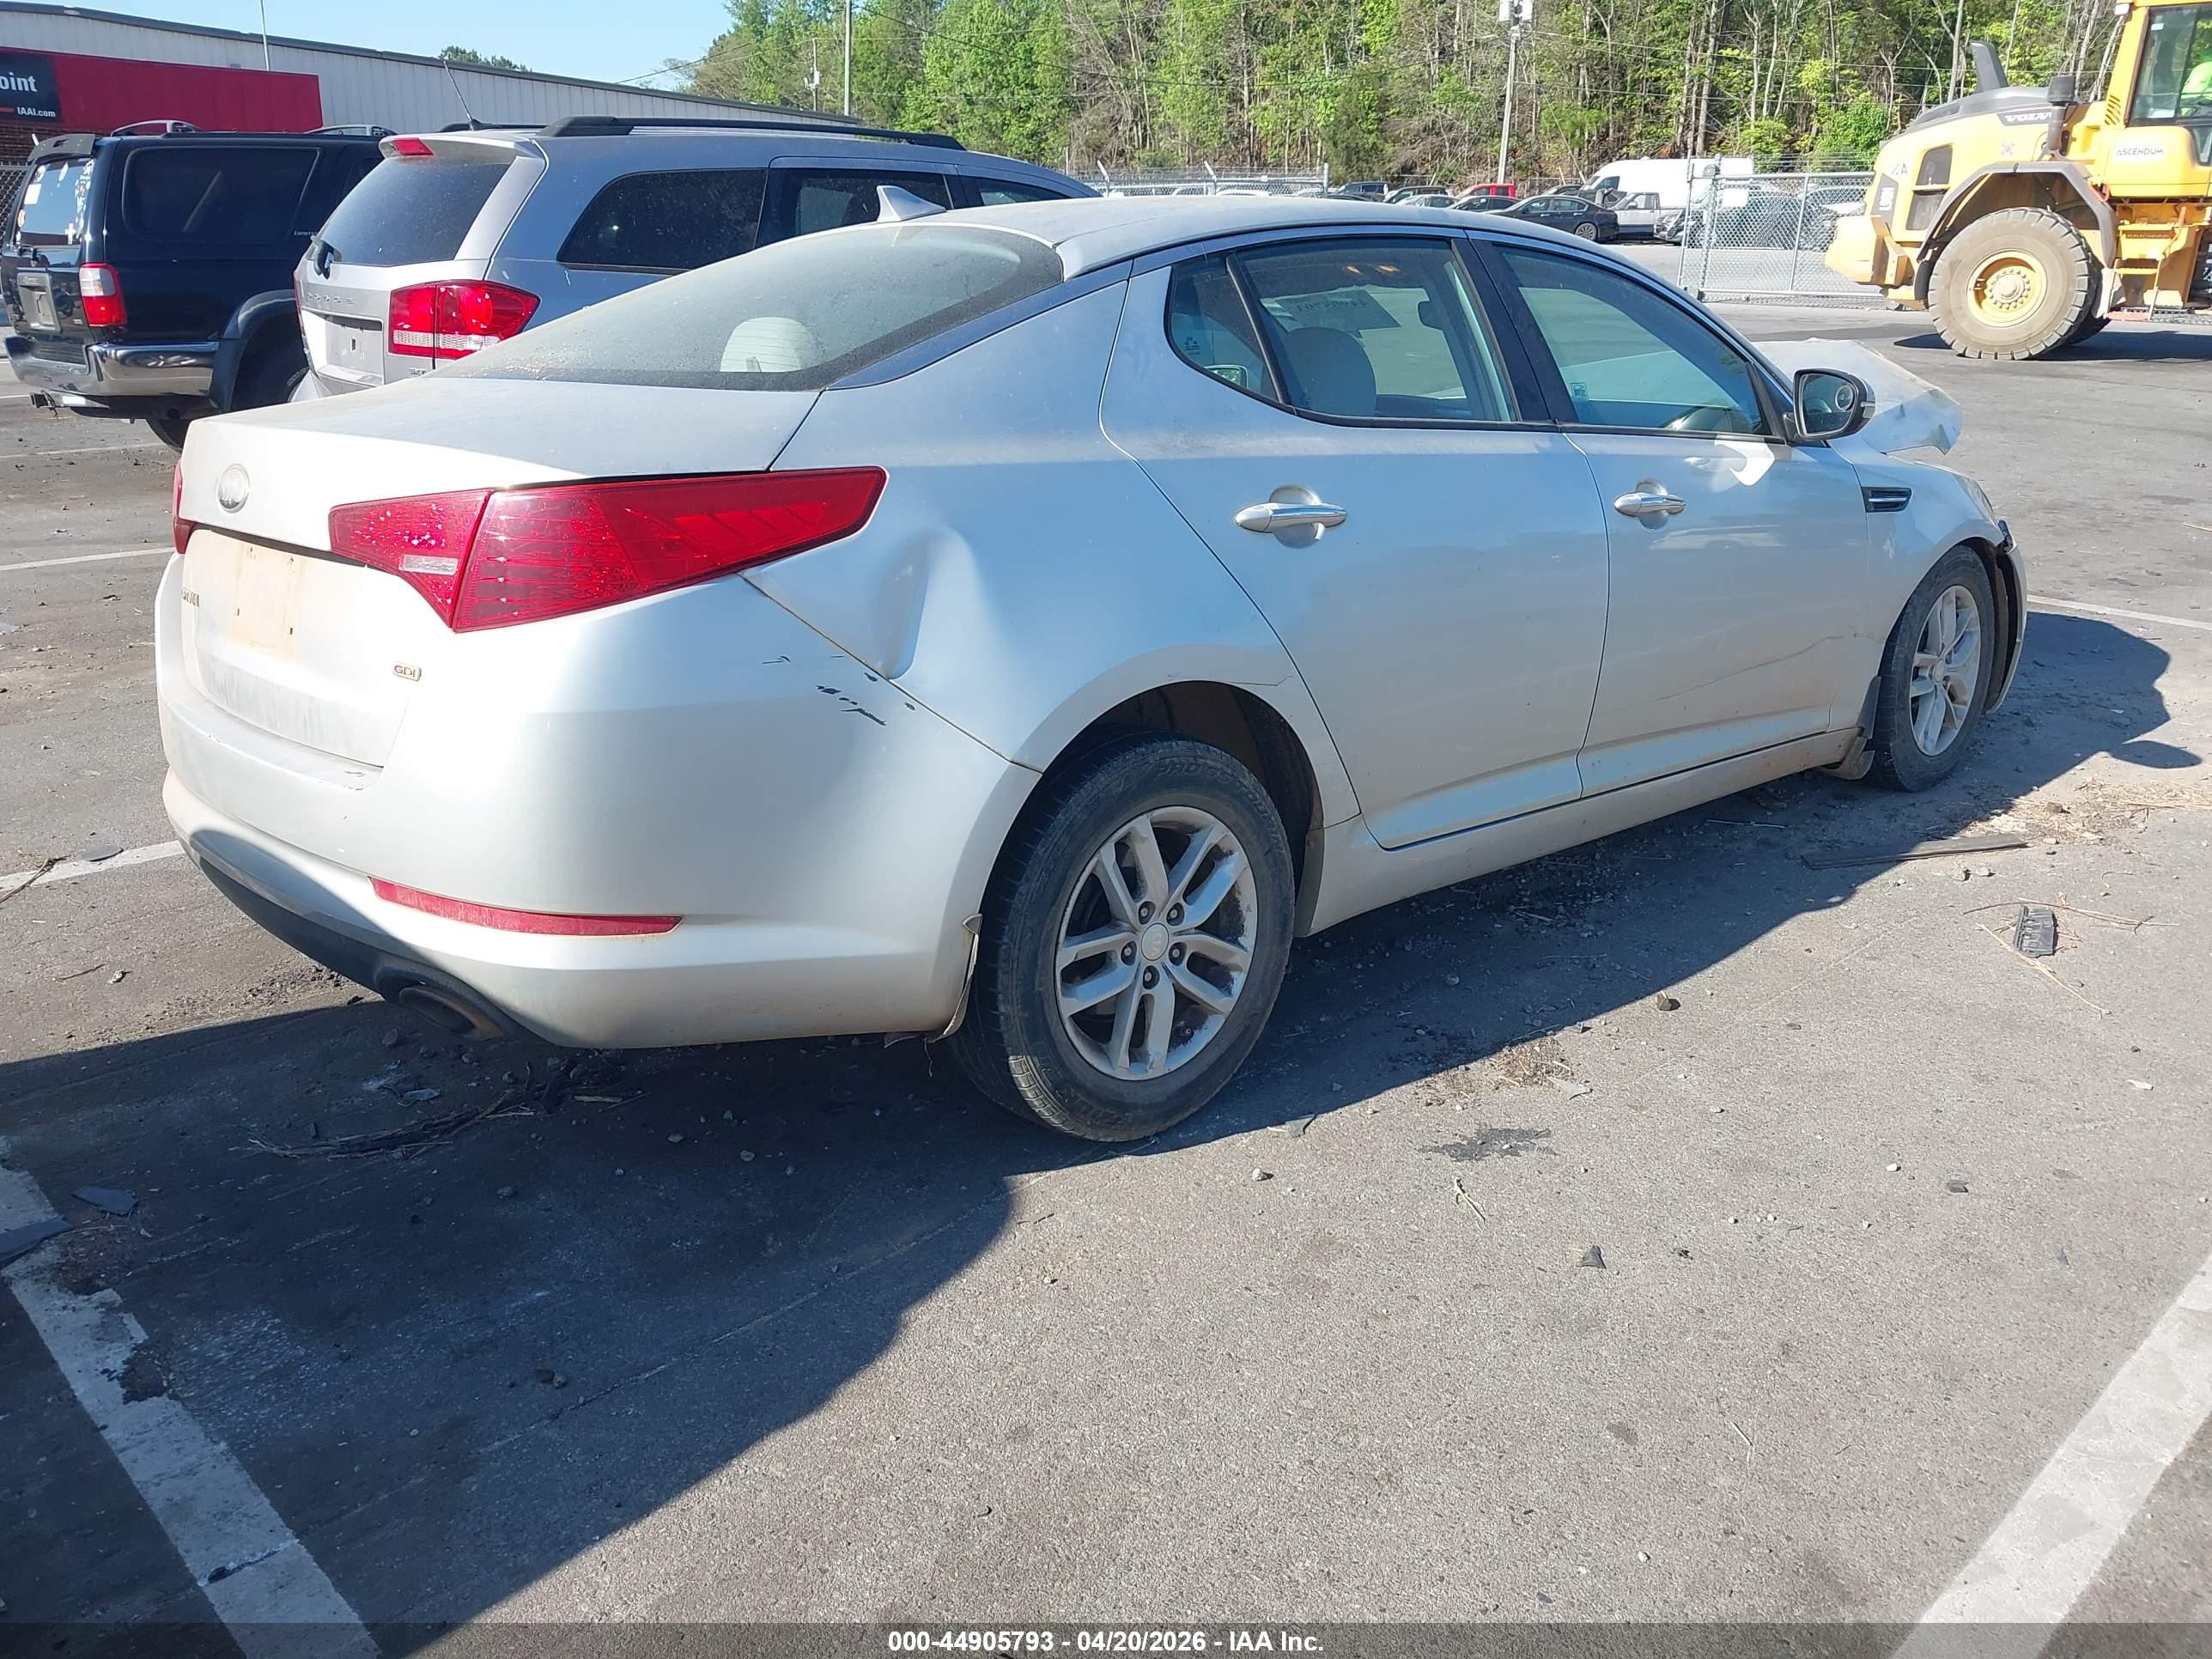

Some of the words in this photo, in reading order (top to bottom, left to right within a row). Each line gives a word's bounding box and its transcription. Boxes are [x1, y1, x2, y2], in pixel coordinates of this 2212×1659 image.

[17, 106, 56, 118] IAAI.com
[2005, 112, 2052, 122] VOLV
[2116, 147, 2164, 155] ASCENDUM
[394, 665, 416, 678] GDI
